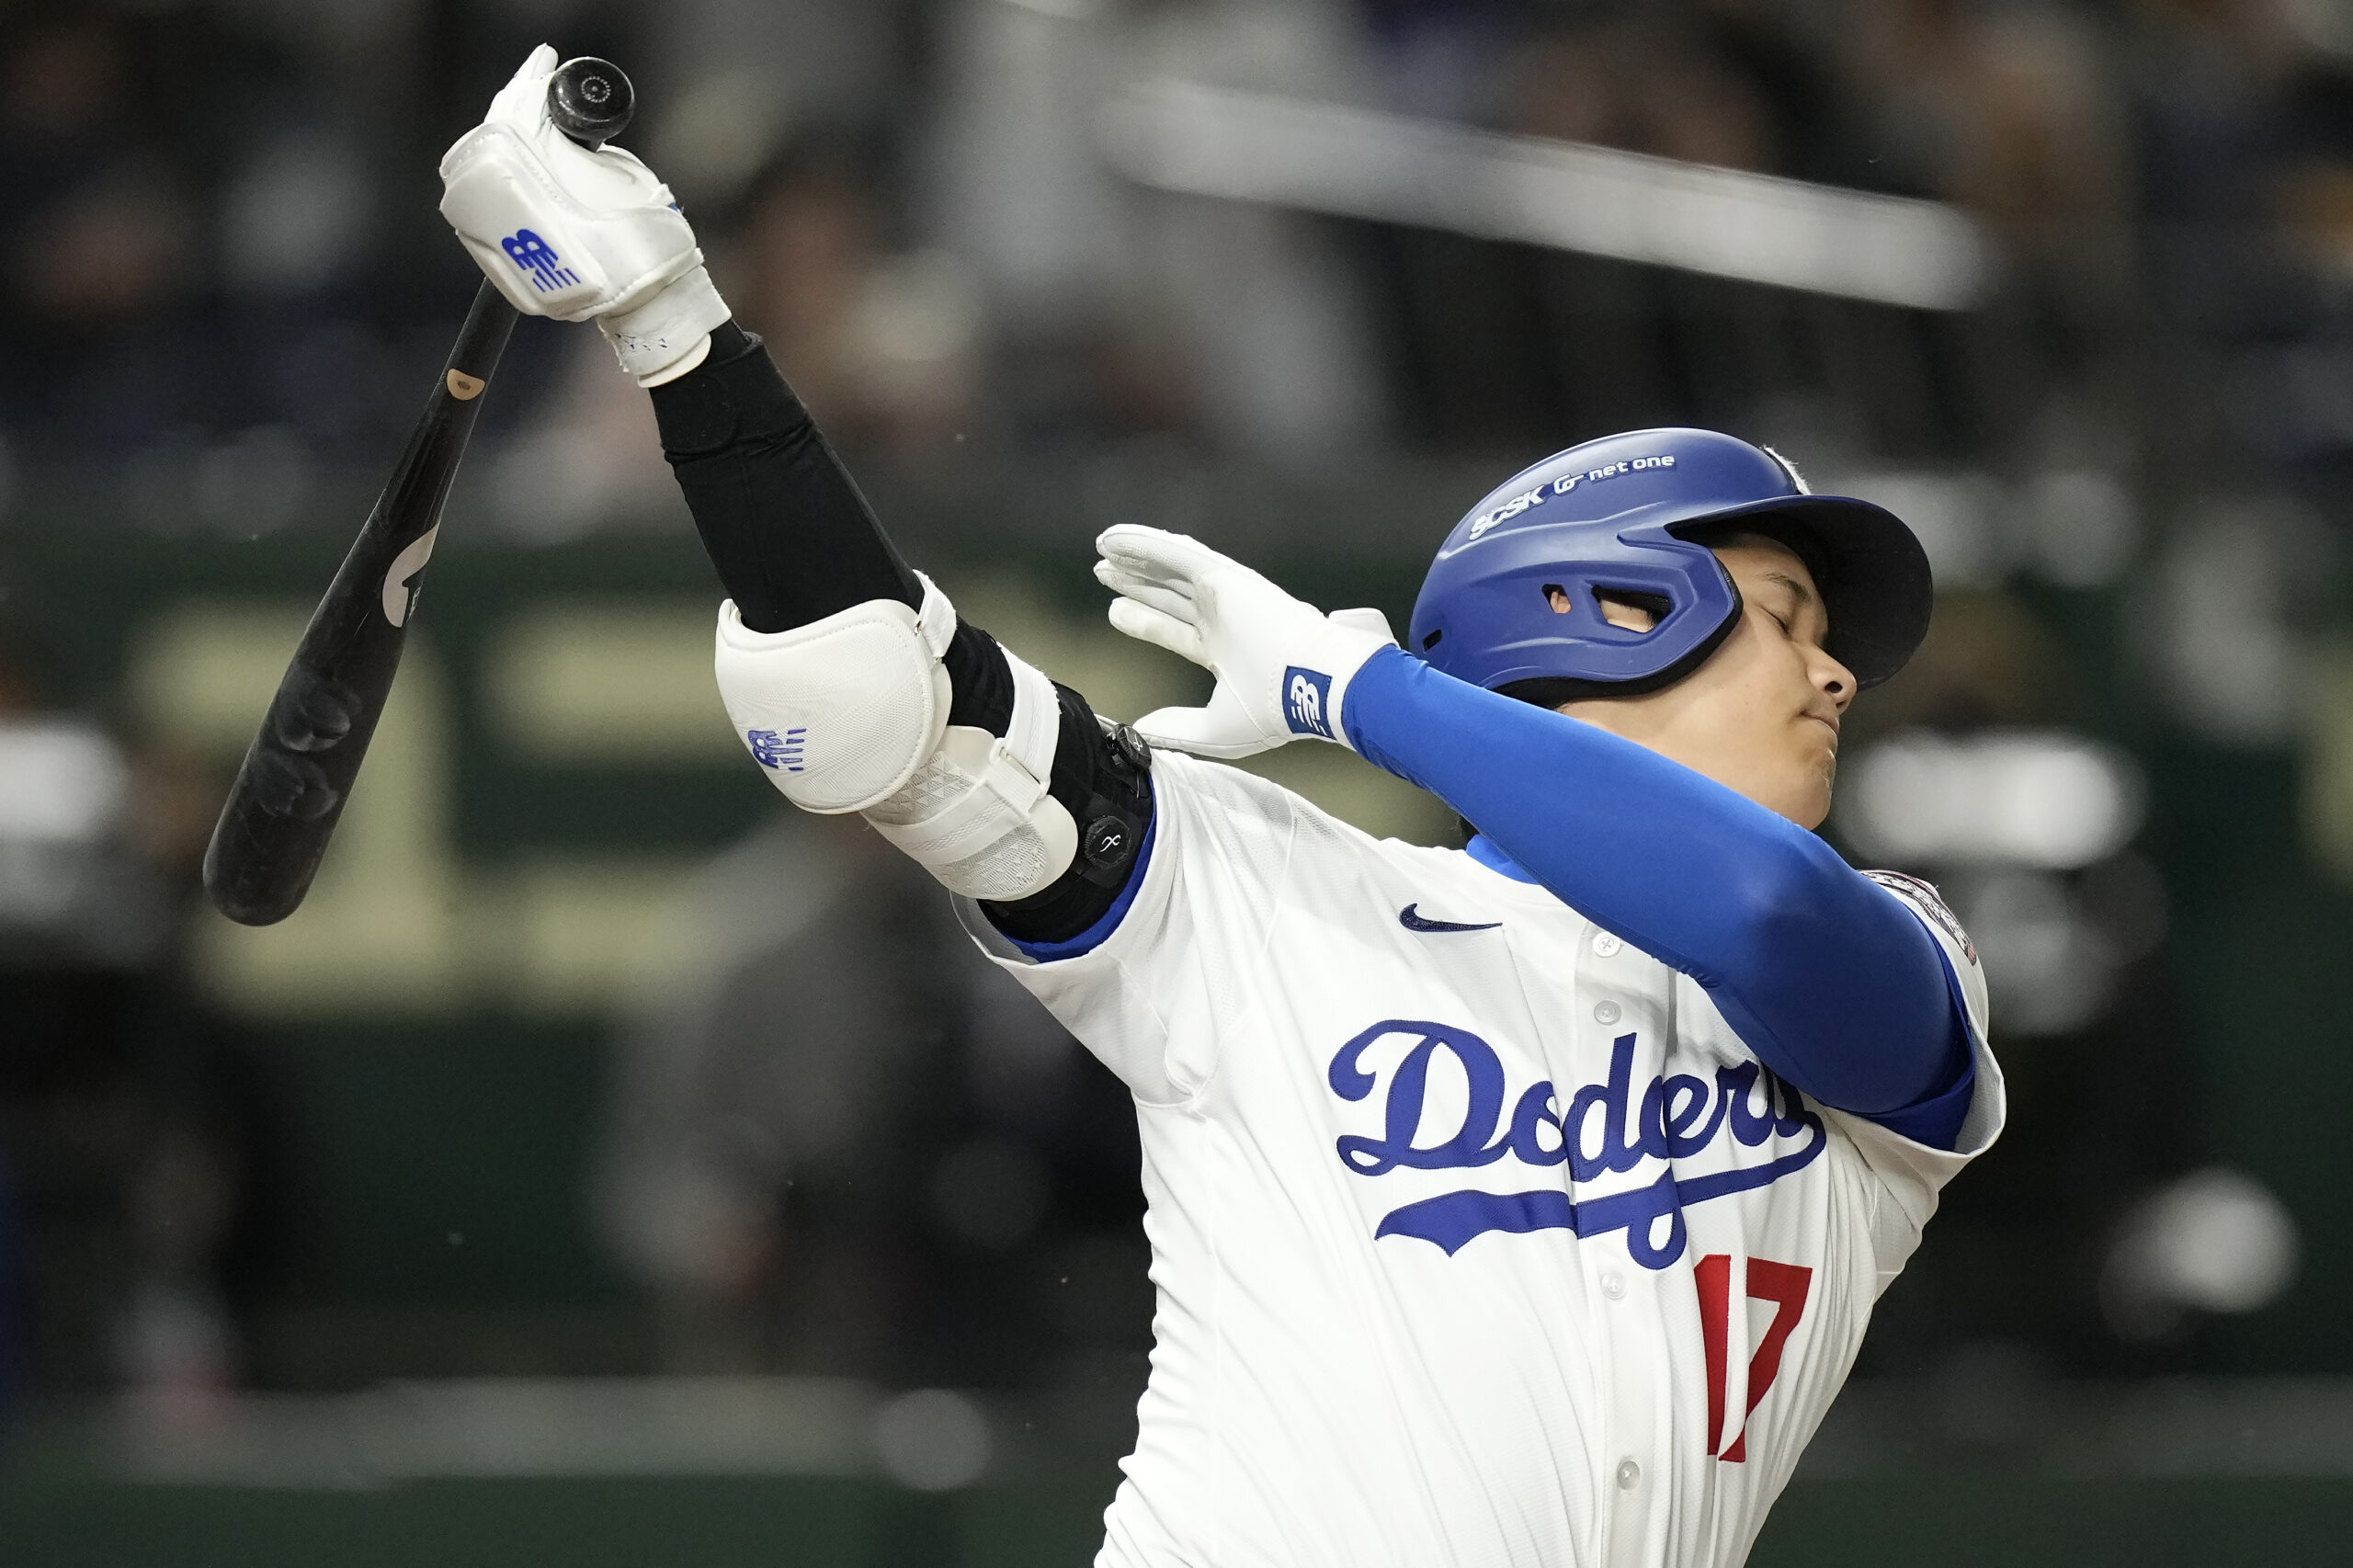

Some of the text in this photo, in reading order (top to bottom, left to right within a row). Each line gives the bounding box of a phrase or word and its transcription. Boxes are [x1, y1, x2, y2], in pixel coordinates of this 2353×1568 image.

[1469, 455, 1675, 540] SCSK net one
[1693, 1254, 1813, 1463] 17
